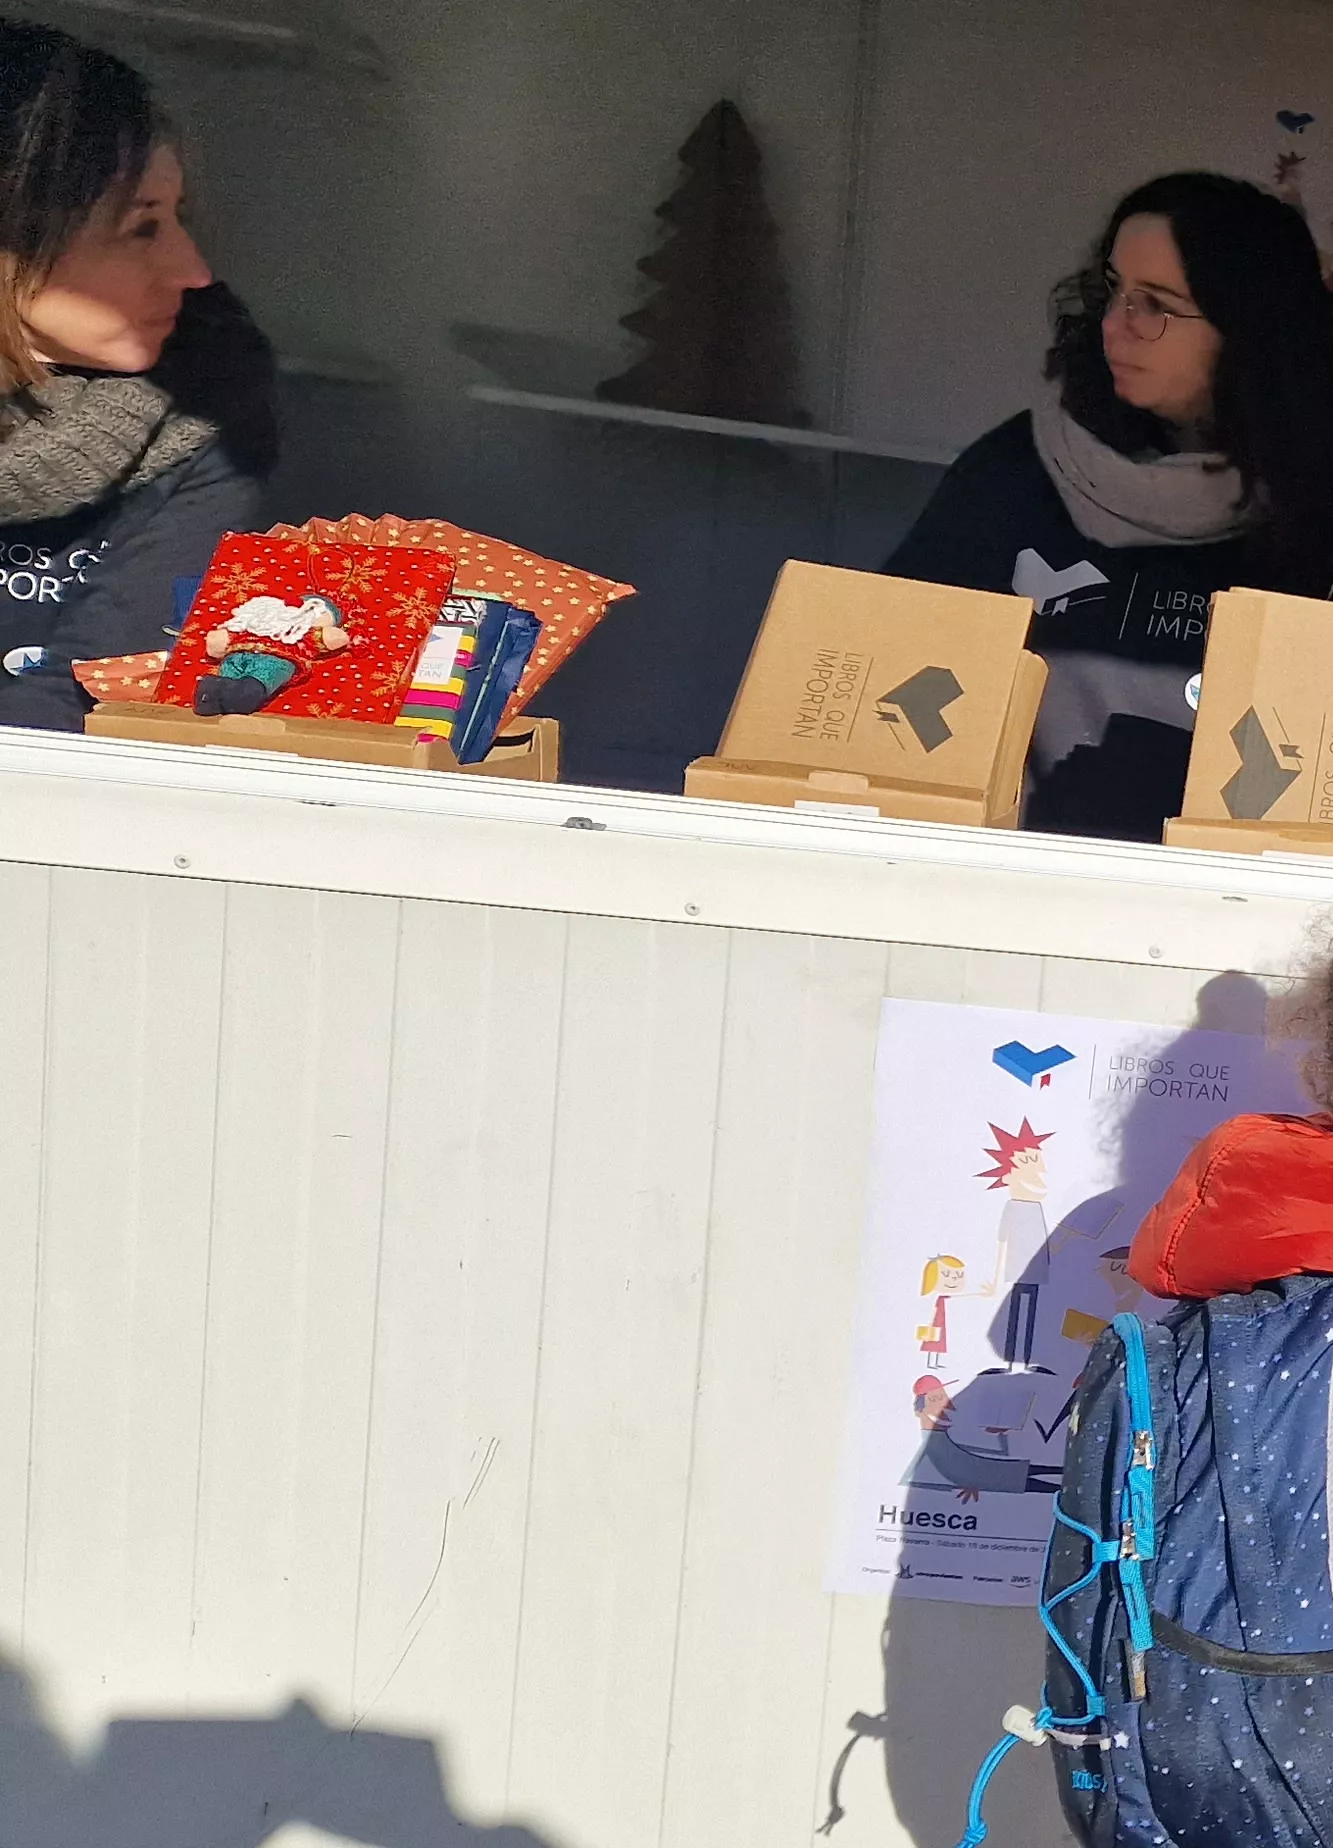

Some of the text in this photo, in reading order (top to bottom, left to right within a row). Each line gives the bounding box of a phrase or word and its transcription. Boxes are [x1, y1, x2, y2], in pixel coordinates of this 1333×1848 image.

[1153, 590, 1209, 616] LIBR
[791, 648, 839, 739] IMPORTAN
[819, 652, 864, 741] LIBROS QUE
[1109, 1055, 1231, 1081] LIBROS QUE
[1106, 1075, 1229, 1102] IMPORTAN
[878, 1503, 978, 1531] Huesca
